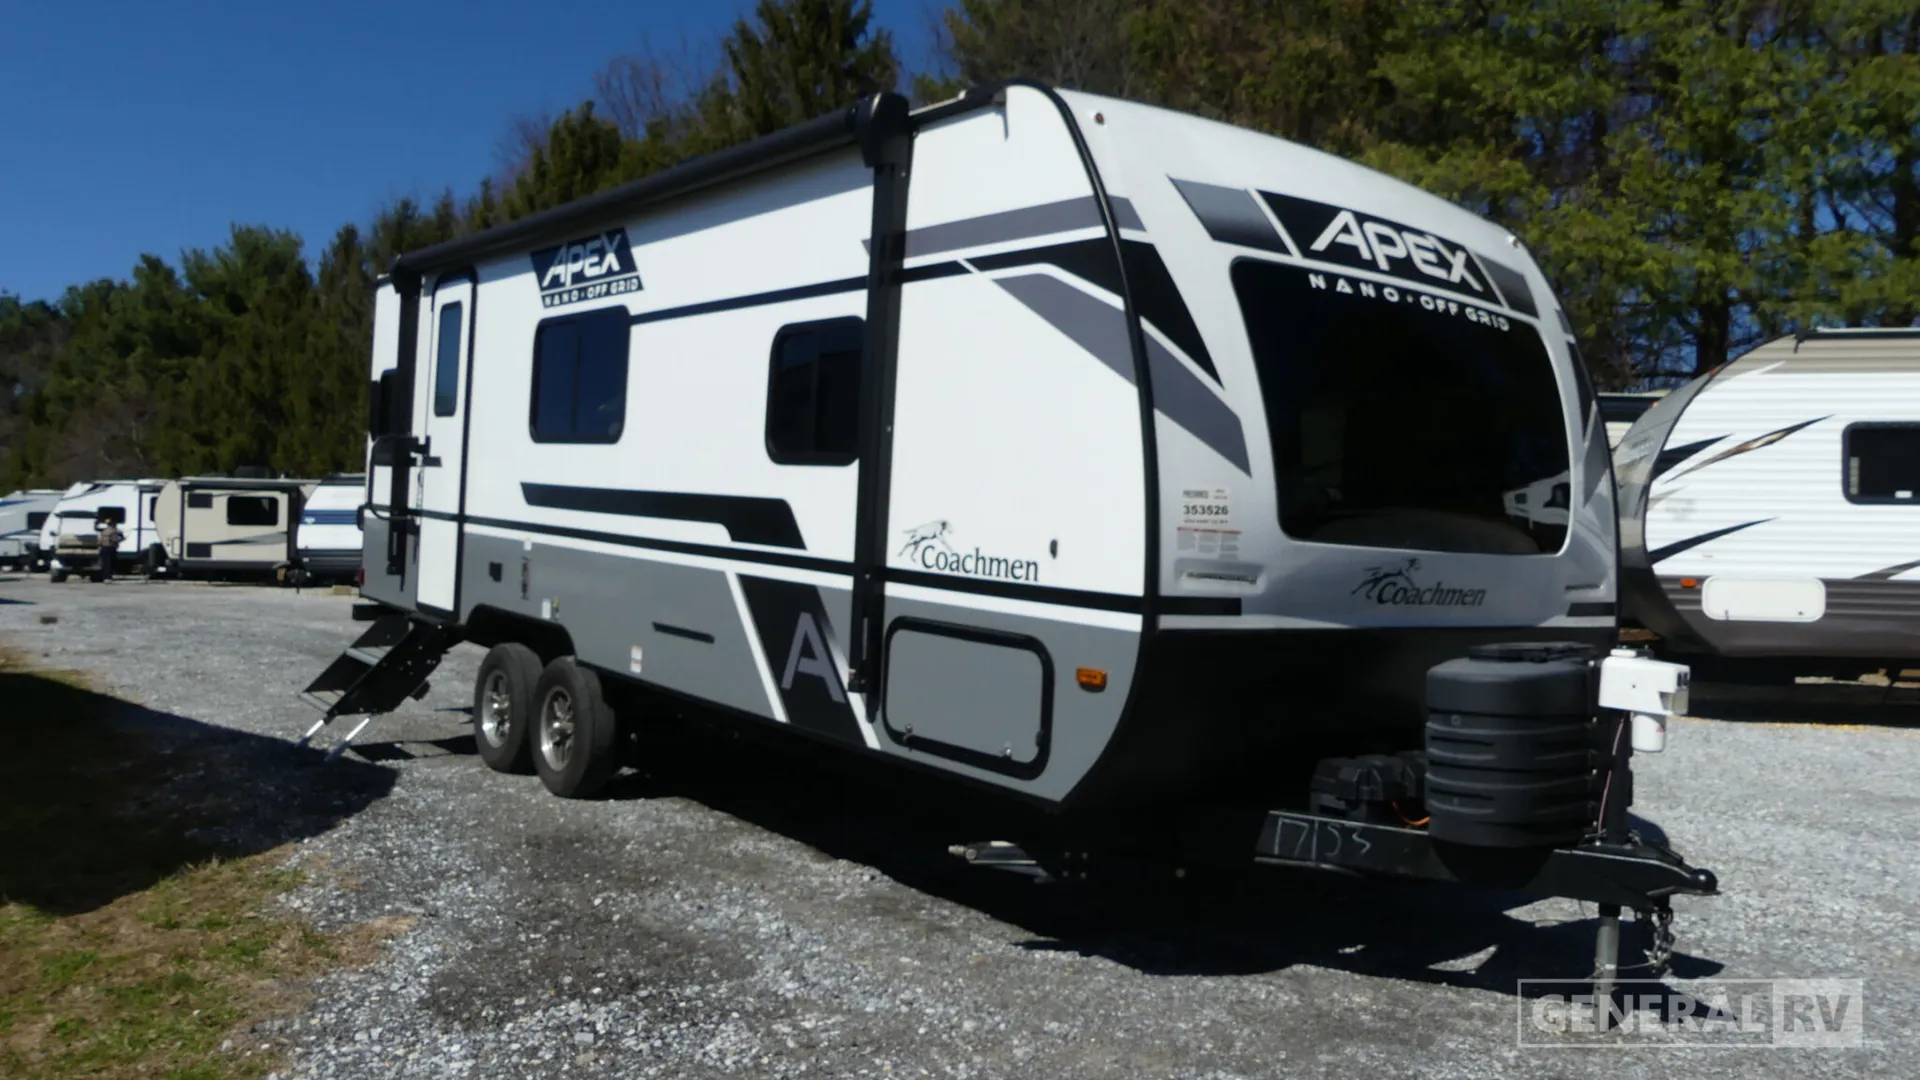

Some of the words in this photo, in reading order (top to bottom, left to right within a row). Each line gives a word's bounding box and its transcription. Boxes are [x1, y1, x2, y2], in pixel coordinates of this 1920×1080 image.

[542, 232, 622, 288] APEX
[1310, 209, 1484, 293] APEX
[609, 278, 639, 295] GRID
[1465, 307, 1511, 332] GRID
[1183, 504, 1229, 515] 353526
[921, 544, 1039, 582] Coachmen
[1376, 580, 1488, 607] Coachmen
[781, 611, 847, 704] A
